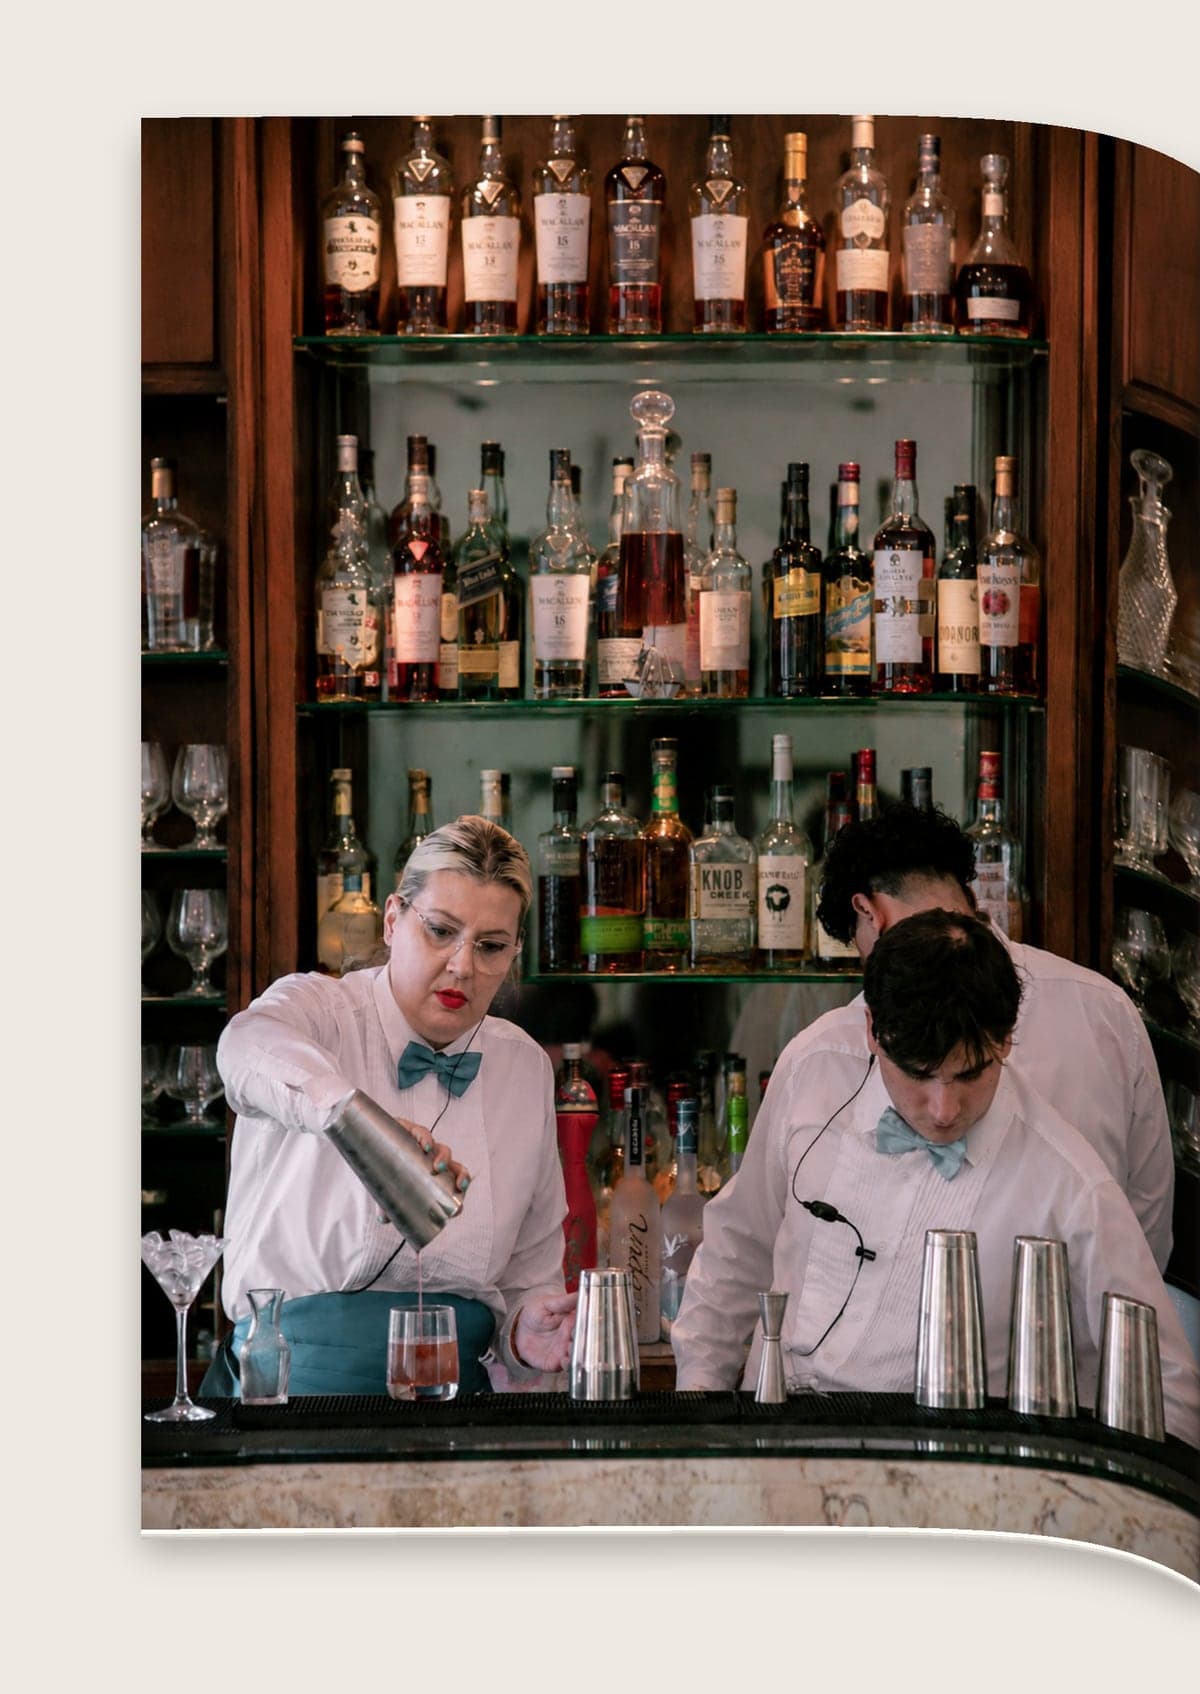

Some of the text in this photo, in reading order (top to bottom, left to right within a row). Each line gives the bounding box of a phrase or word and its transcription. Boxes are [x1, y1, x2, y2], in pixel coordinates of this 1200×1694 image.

[613, 224, 656, 233] MACALLAN
[702, 869, 743, 890] KNOB
[710, 890, 751, 899] CREEK
